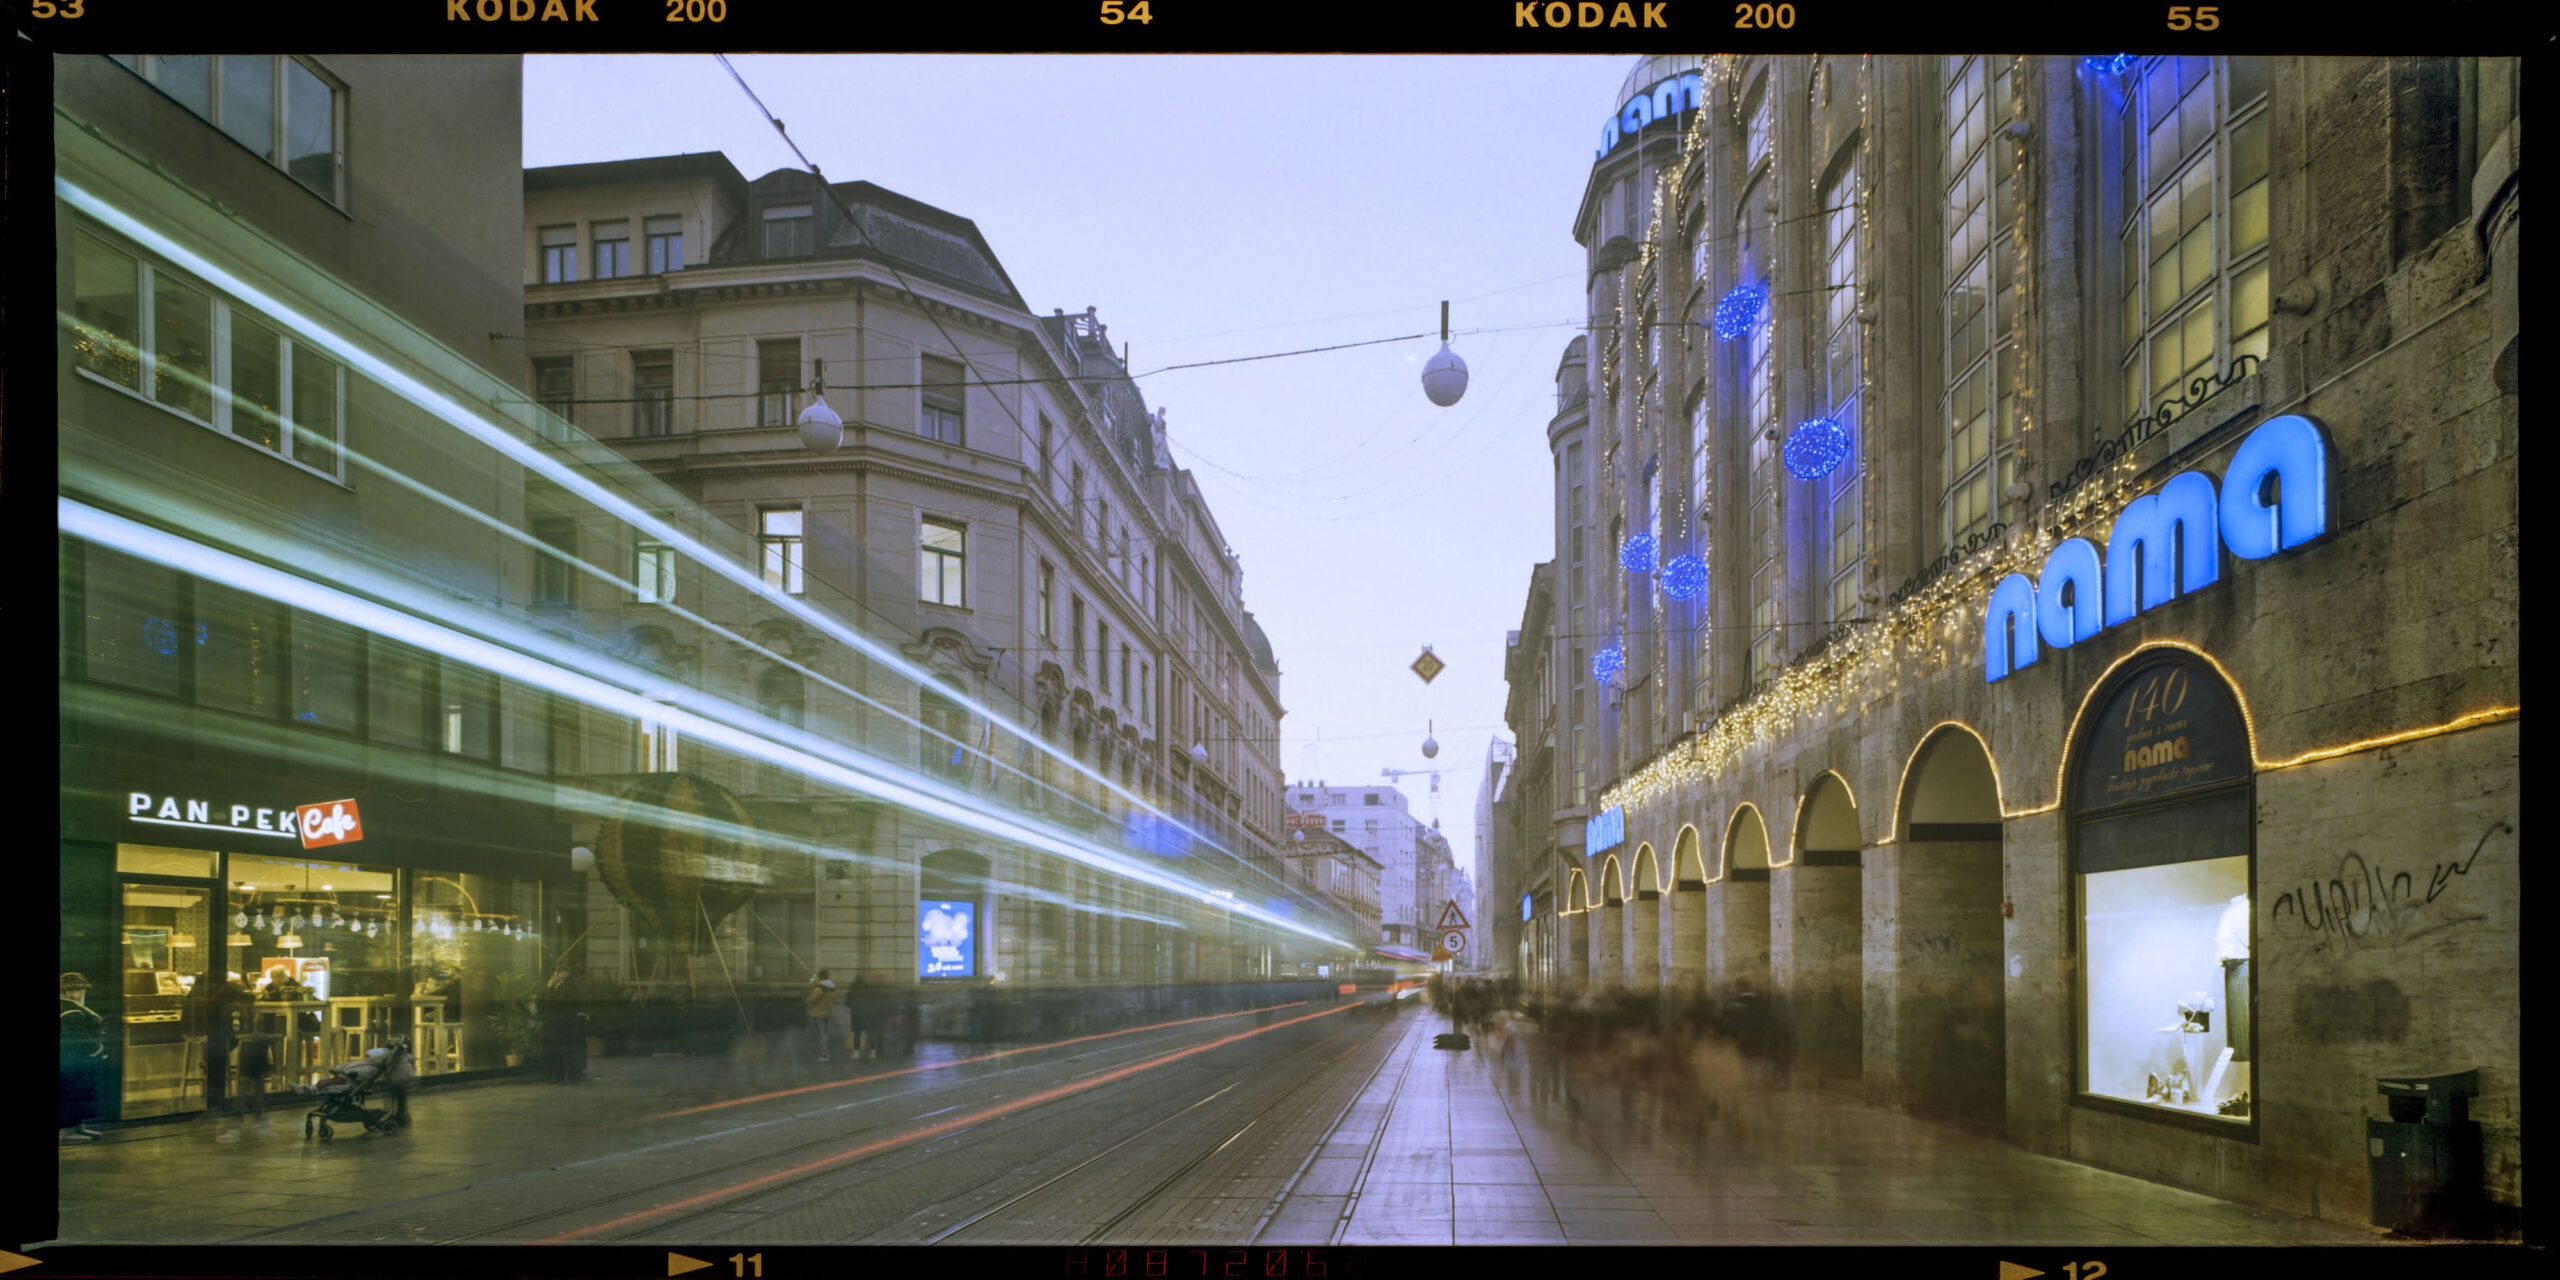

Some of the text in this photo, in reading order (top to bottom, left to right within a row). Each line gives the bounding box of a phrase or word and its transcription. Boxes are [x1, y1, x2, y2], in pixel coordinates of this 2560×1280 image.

[32, 0, 85, 19] 53
[447, 0, 727, 22] KODAK 200
[1100, 0, 1153, 24] 54
[1515, 2, 1796, 29] KODAK 200
[2167, 6, 2220, 31] 55
[1985, 415, 2328, 684] nama
[2124, 667, 2189, 729] 140
[2124, 736, 2190, 773] nama
[129, 792, 297, 833] PAN PEK
[303, 804, 357, 841] Cafe
[1450, 935, 1458, 948] 5
[729, 1253, 762, 1277] 11
[2063, 1261, 2107, 1280] 12
